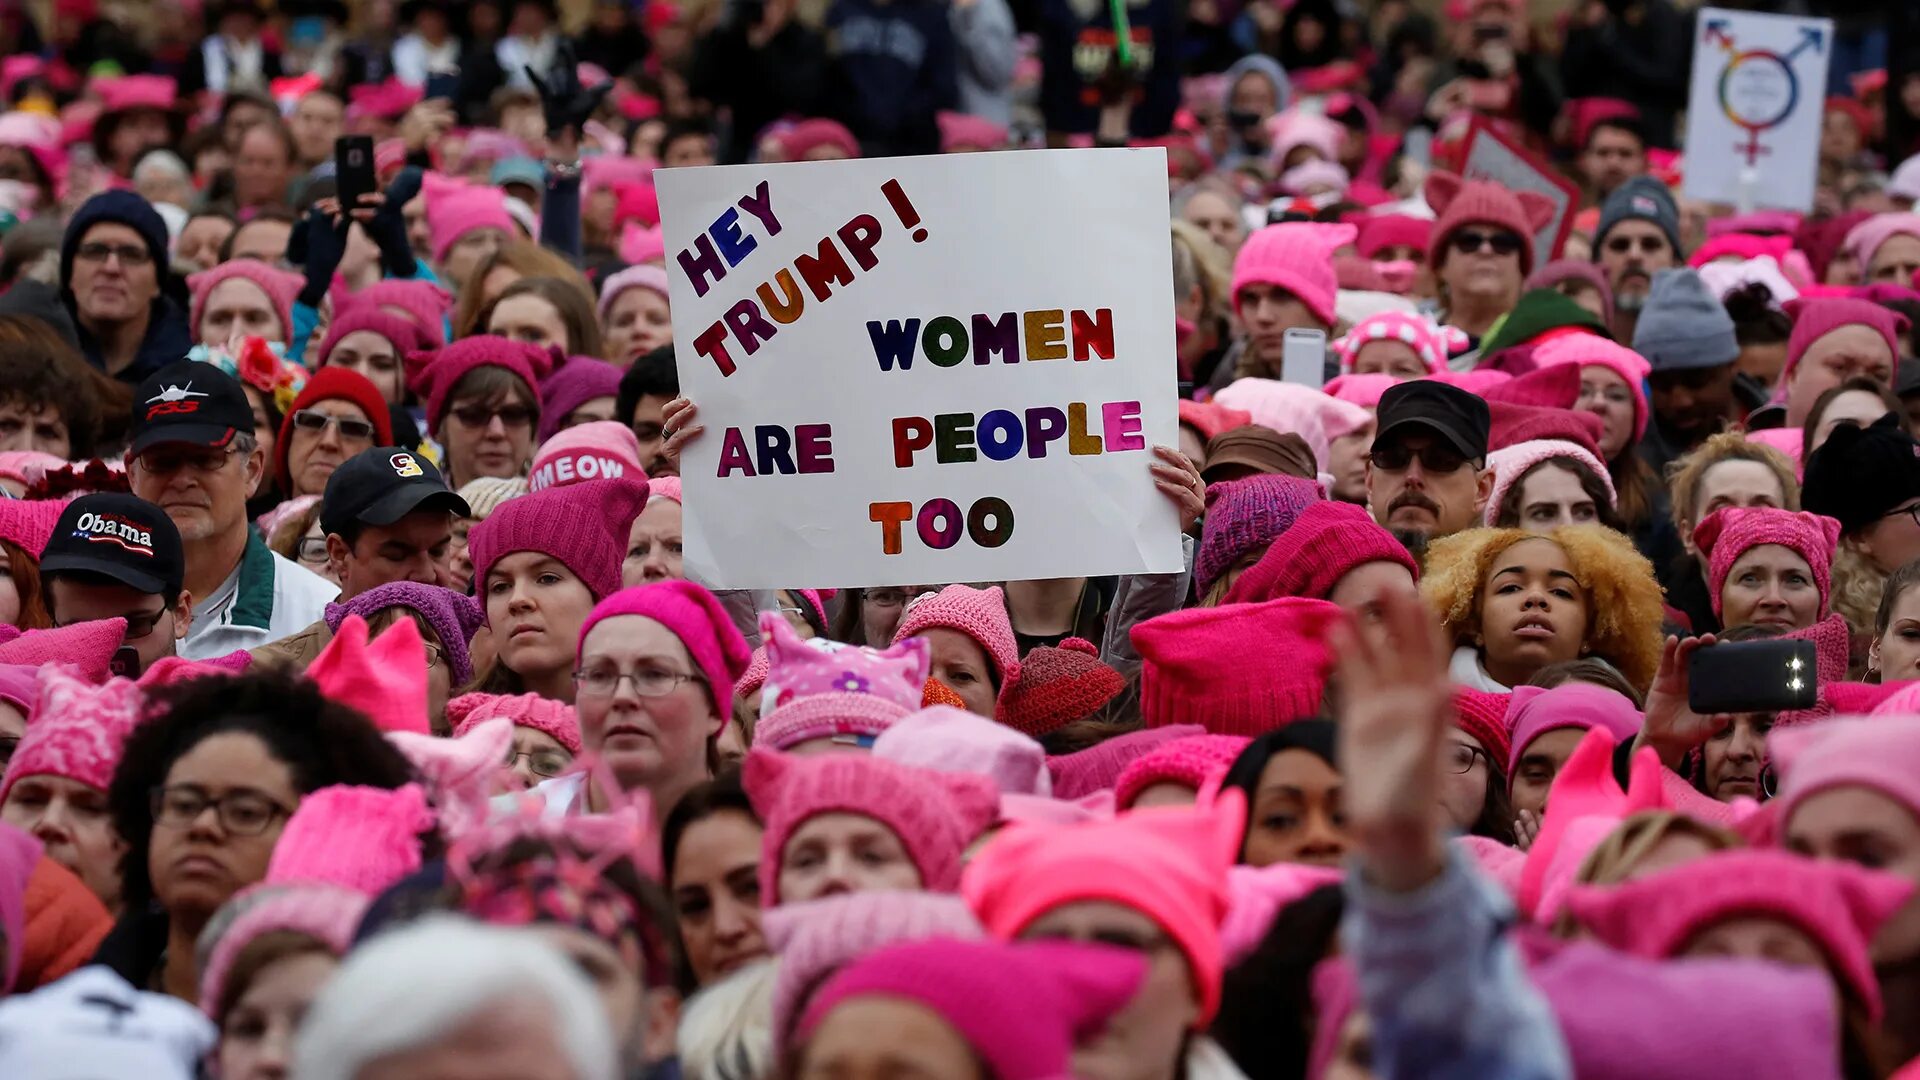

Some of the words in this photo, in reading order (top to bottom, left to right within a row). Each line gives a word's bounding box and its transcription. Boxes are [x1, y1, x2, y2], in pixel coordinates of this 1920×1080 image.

[677, 180, 783, 298] HEY
[866, 309, 1116, 372] WOMEN
[717, 424, 836, 478] ARE
[892, 400, 1146, 469] PEOPLE
[77, 512, 153, 547] Obama
[869, 497, 1015, 556] TOO
